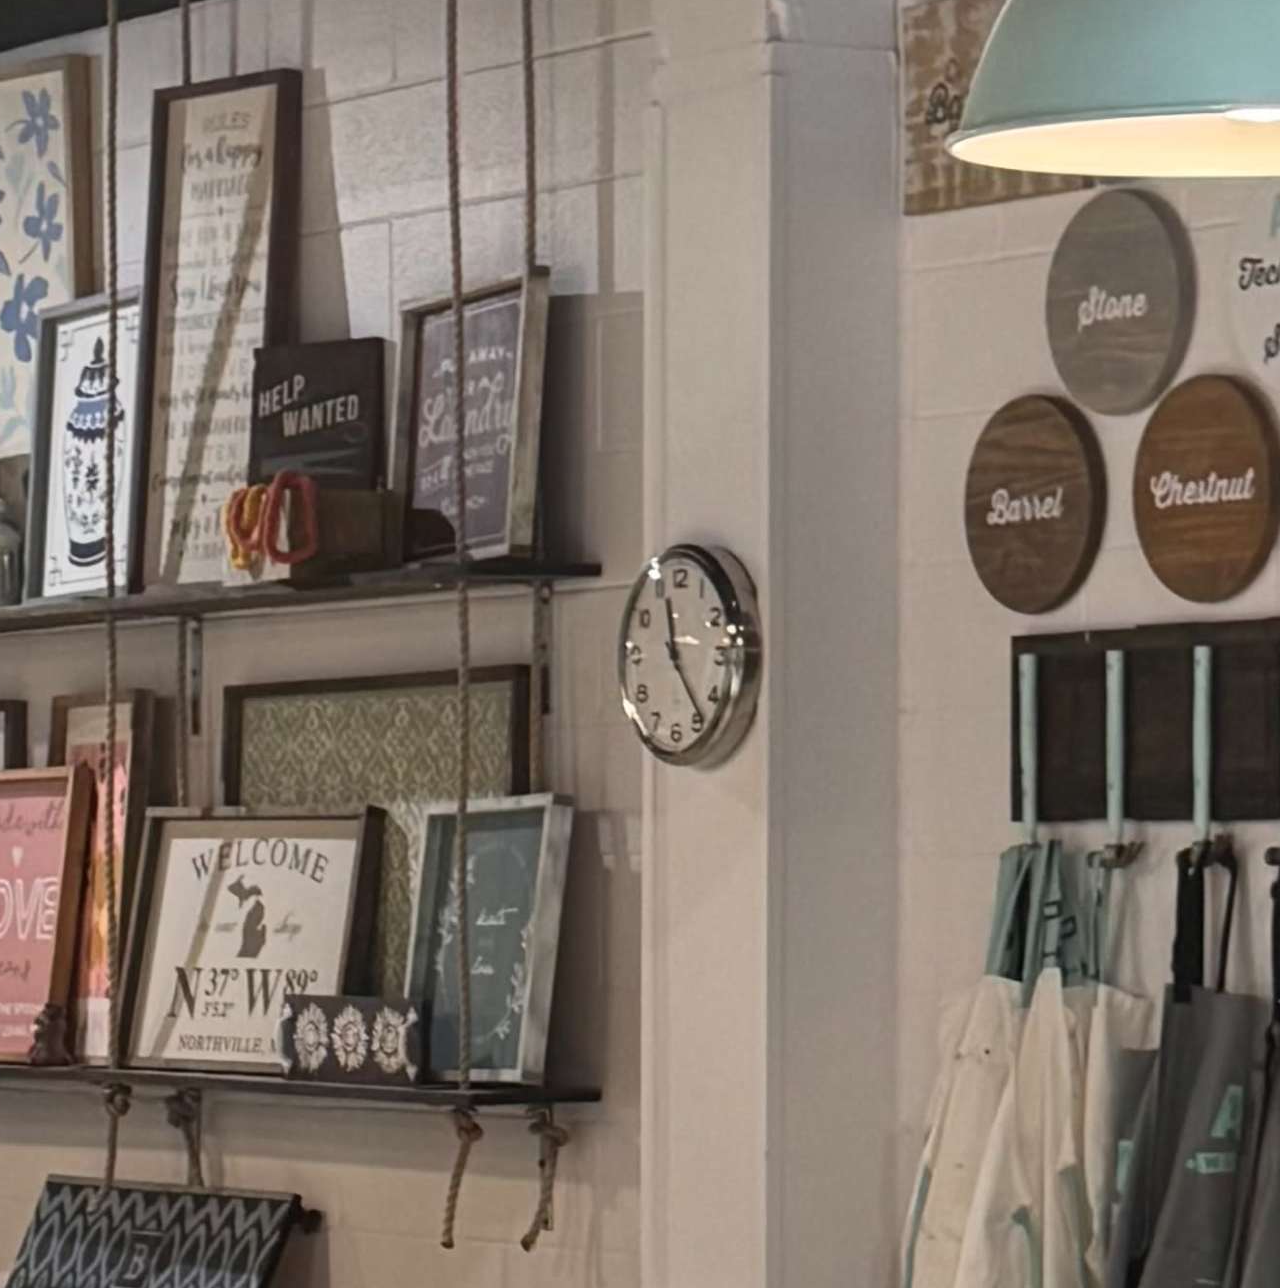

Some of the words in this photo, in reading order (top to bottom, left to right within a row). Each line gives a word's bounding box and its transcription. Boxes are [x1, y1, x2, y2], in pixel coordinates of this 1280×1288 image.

[1076, 285, 1147, 334] Stone
[258, 374, 305, 419] HELP
[282, 394, 359, 438] WANTED
[987, 488, 1064, 527] Barrel
[1149, 466, 1256, 510] Chestnut
[671, 568, 689, 590] 12
[636, 684, 648, 703] 8
[708, 685, 719, 704] 4
[671, 723, 683, 743] 6
[191, 837, 330, 884] WELCOME
[167, 966, 203, 1019] N
[245, 967, 283, 1017] W
[178, 1034, 265, 1056] NORTHVILLE,
[123, 1243, 149, 1280] B
